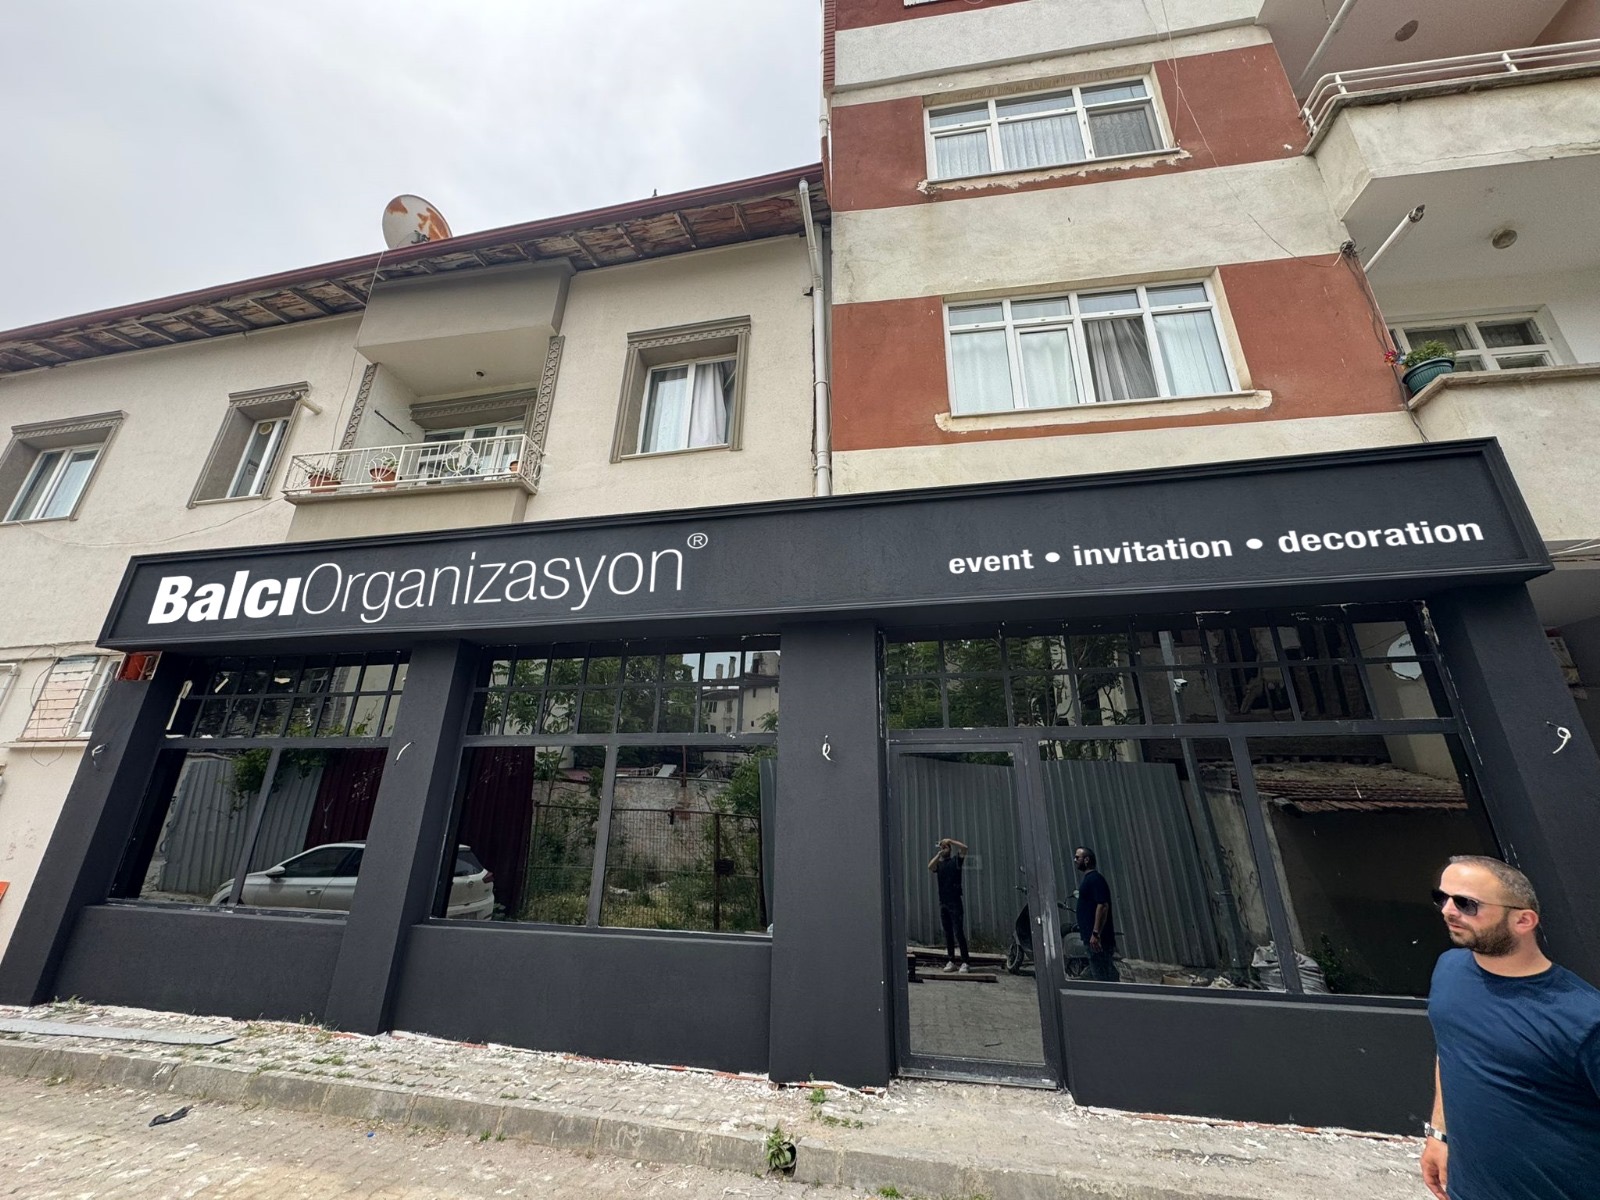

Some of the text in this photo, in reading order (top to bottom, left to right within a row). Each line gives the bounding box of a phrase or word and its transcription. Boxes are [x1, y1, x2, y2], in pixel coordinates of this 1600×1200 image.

[948, 520, 1485, 575] event invitation decoration
